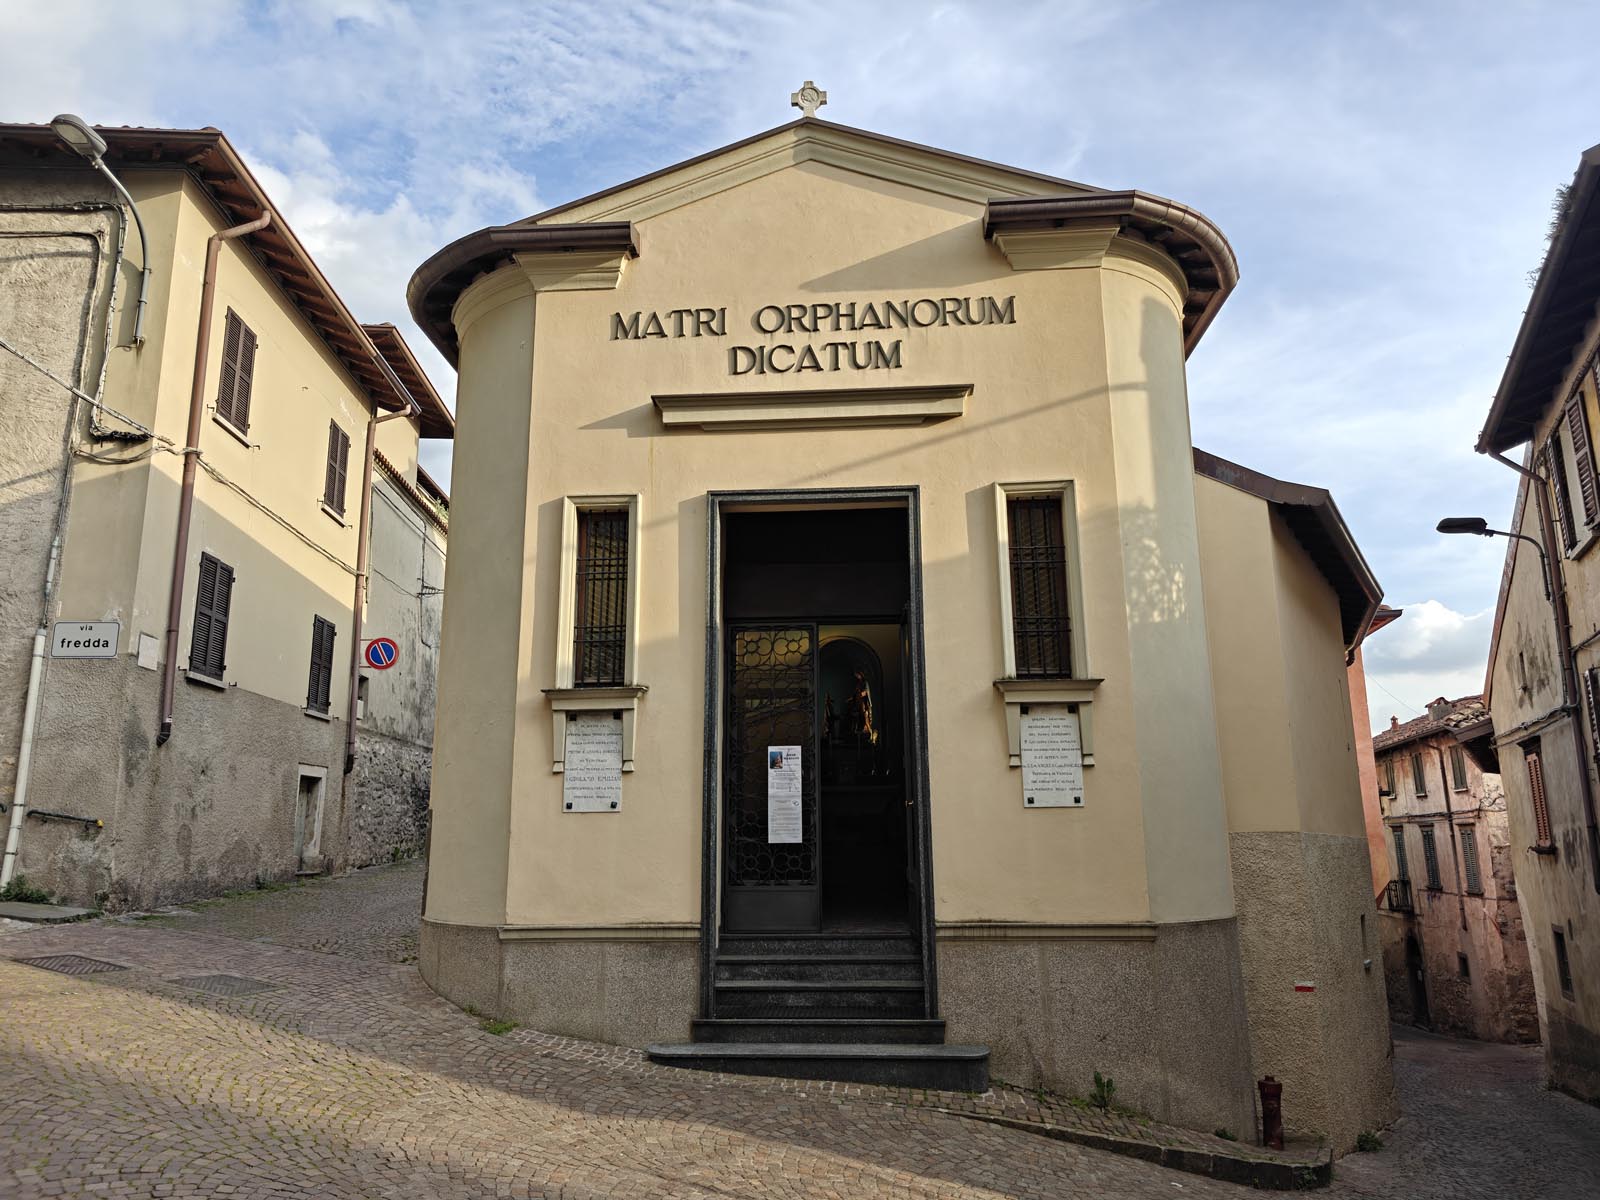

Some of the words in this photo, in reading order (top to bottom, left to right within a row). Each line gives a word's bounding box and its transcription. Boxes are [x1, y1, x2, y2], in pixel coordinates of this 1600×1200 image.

[612, 307, 728, 340] MATRI
[756, 295, 1017, 334] ORPHANORUM
[730, 339, 903, 376] DICATUM
[60, 637, 109, 649] fredda
